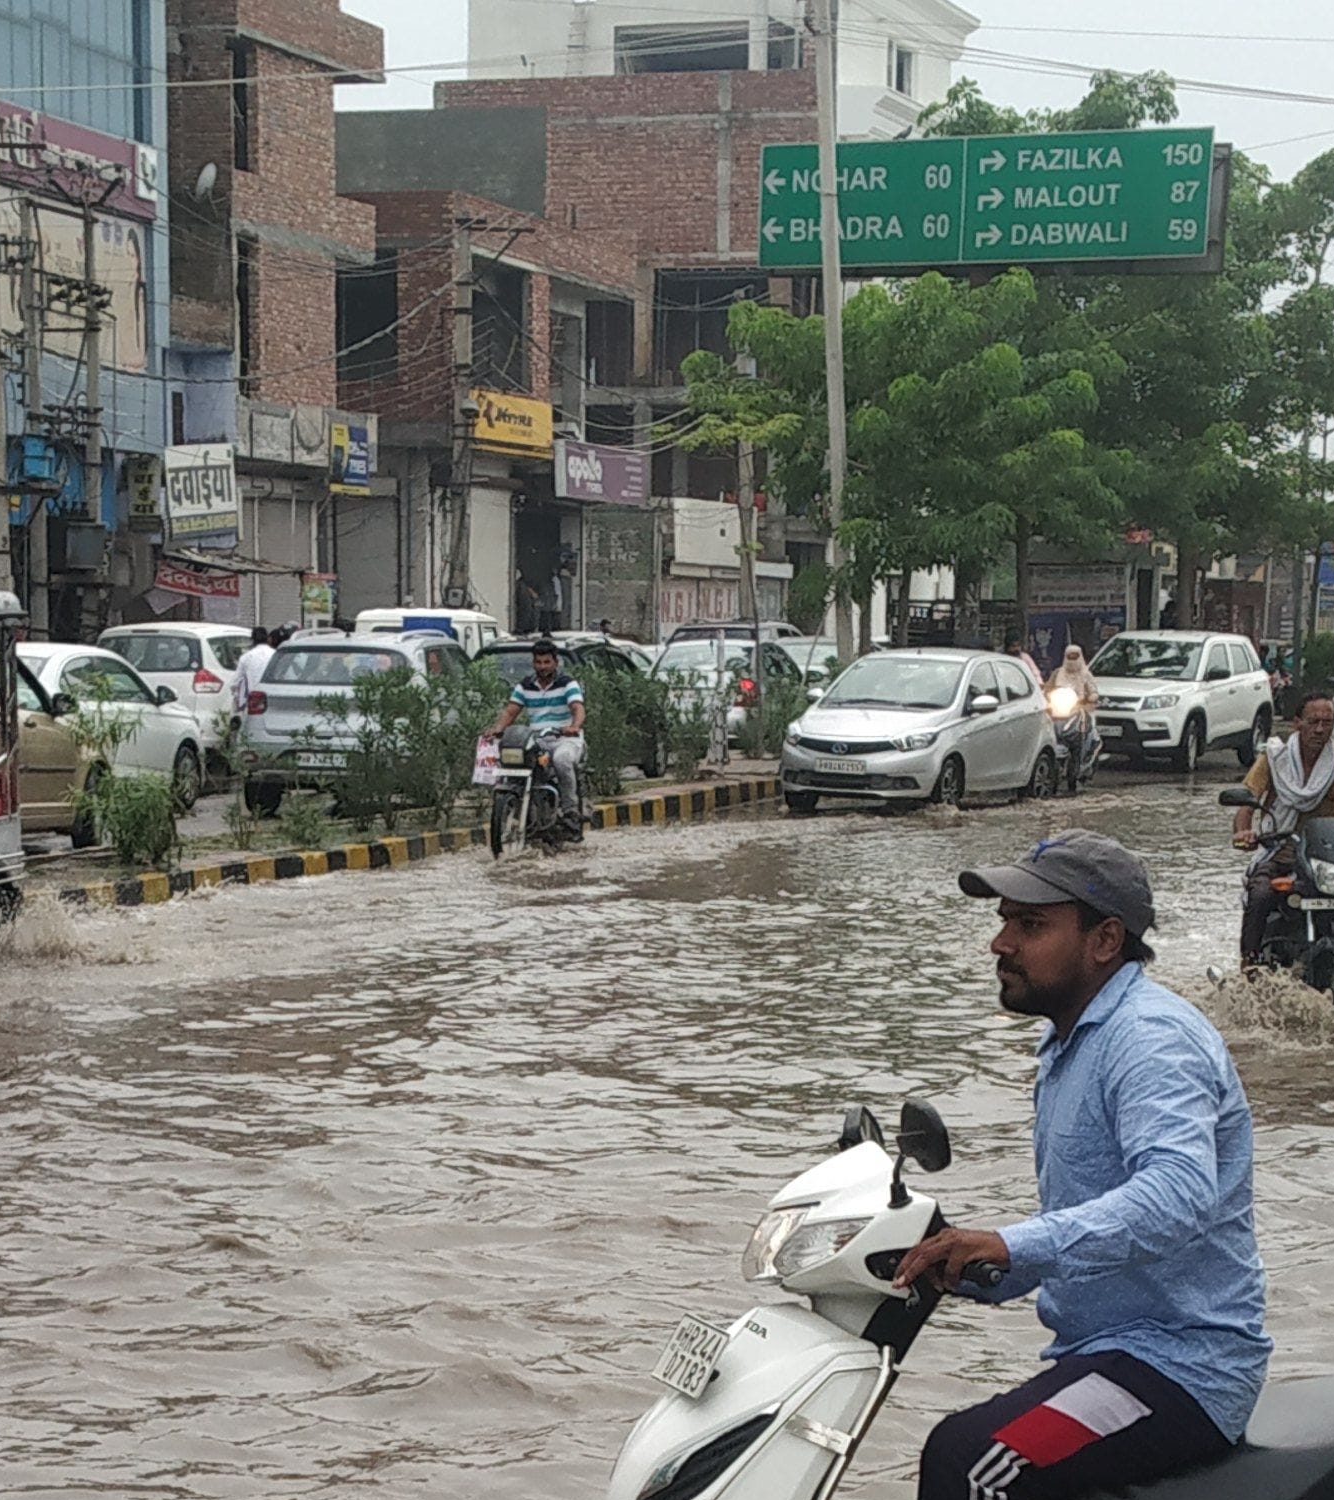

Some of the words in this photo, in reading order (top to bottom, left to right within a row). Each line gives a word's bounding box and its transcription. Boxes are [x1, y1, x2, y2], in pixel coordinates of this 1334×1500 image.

[1017, 146, 1124, 172] FAZILKA
[1161, 143, 1204, 167] 150
[924, 164, 952, 190] 60
[1013, 183, 1122, 209] MALOUT
[1170, 180, 1201, 204] 87
[921, 213, 950, 239] 60
[1009, 220, 1128, 246] DABWALI
[1167, 218, 1198, 242] 59
